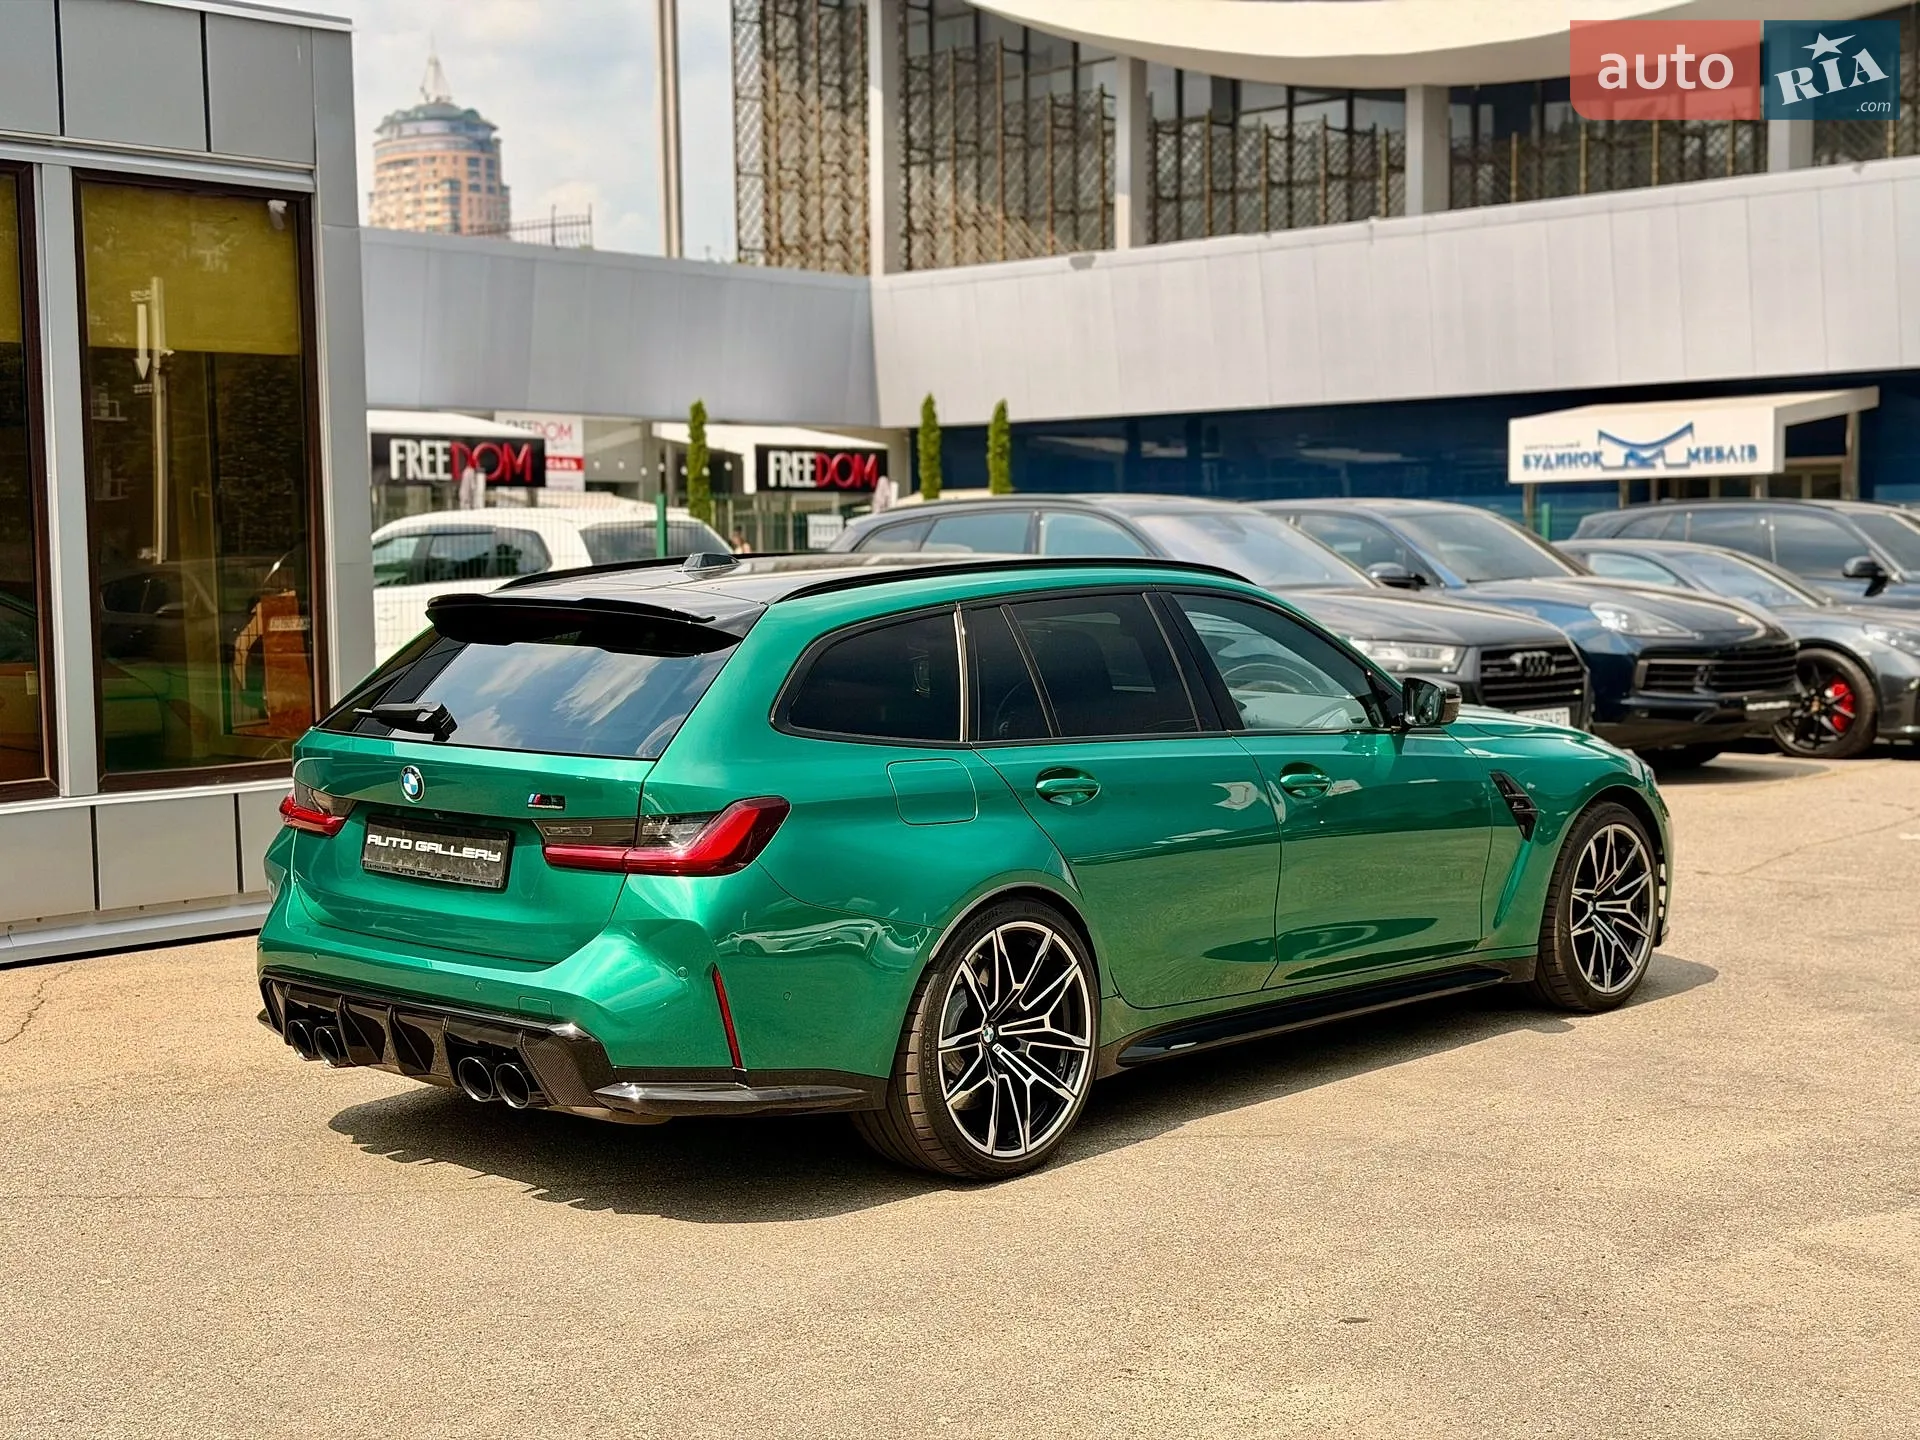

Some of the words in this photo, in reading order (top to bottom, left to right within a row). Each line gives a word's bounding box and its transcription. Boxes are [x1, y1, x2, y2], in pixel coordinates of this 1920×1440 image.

[390, 438, 532, 482] FREEDOM
[768, 450, 878, 488] FREEDOM
[367, 834, 413, 850] AUTO
[415, 841, 502, 862] GALLERY
